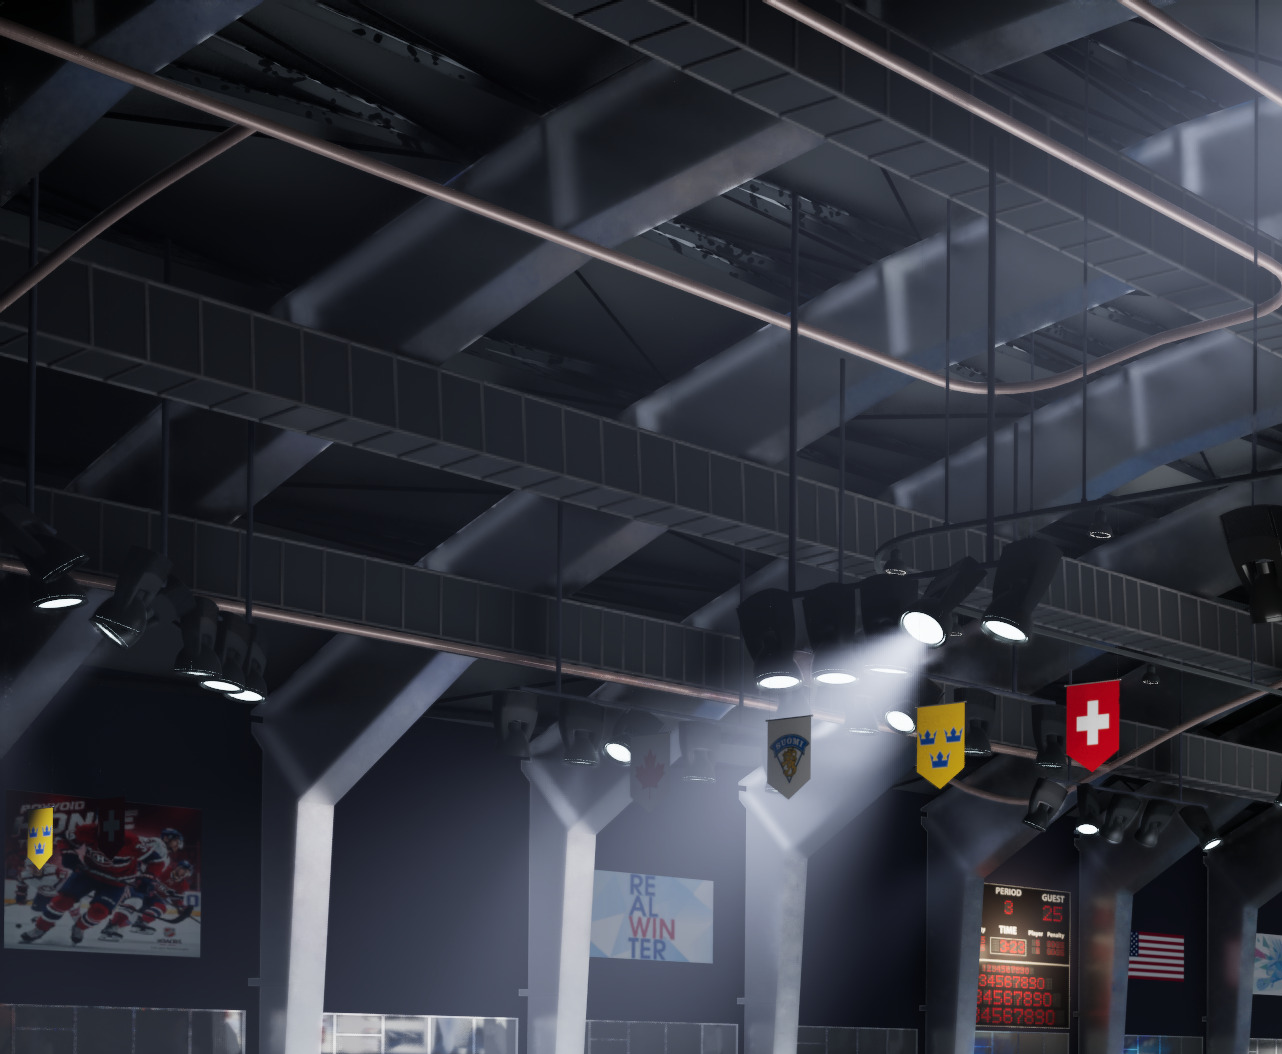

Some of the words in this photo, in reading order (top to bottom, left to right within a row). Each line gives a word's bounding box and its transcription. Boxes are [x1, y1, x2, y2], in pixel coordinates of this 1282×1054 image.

[775, 737, 804, 750] SUOMI
[629, 873, 656, 897] RE
[995, 886, 1022, 897] PERIOD
[1041, 893, 1065, 903] GUEST
[629, 895, 659, 918] AL
[1003, 900, 1014, 915] 3
[1042, 905, 1063, 922] 25
[628, 915, 675, 940] WIN
[998, 924, 1018, 936] TIME
[628, 937, 667, 960] TER
